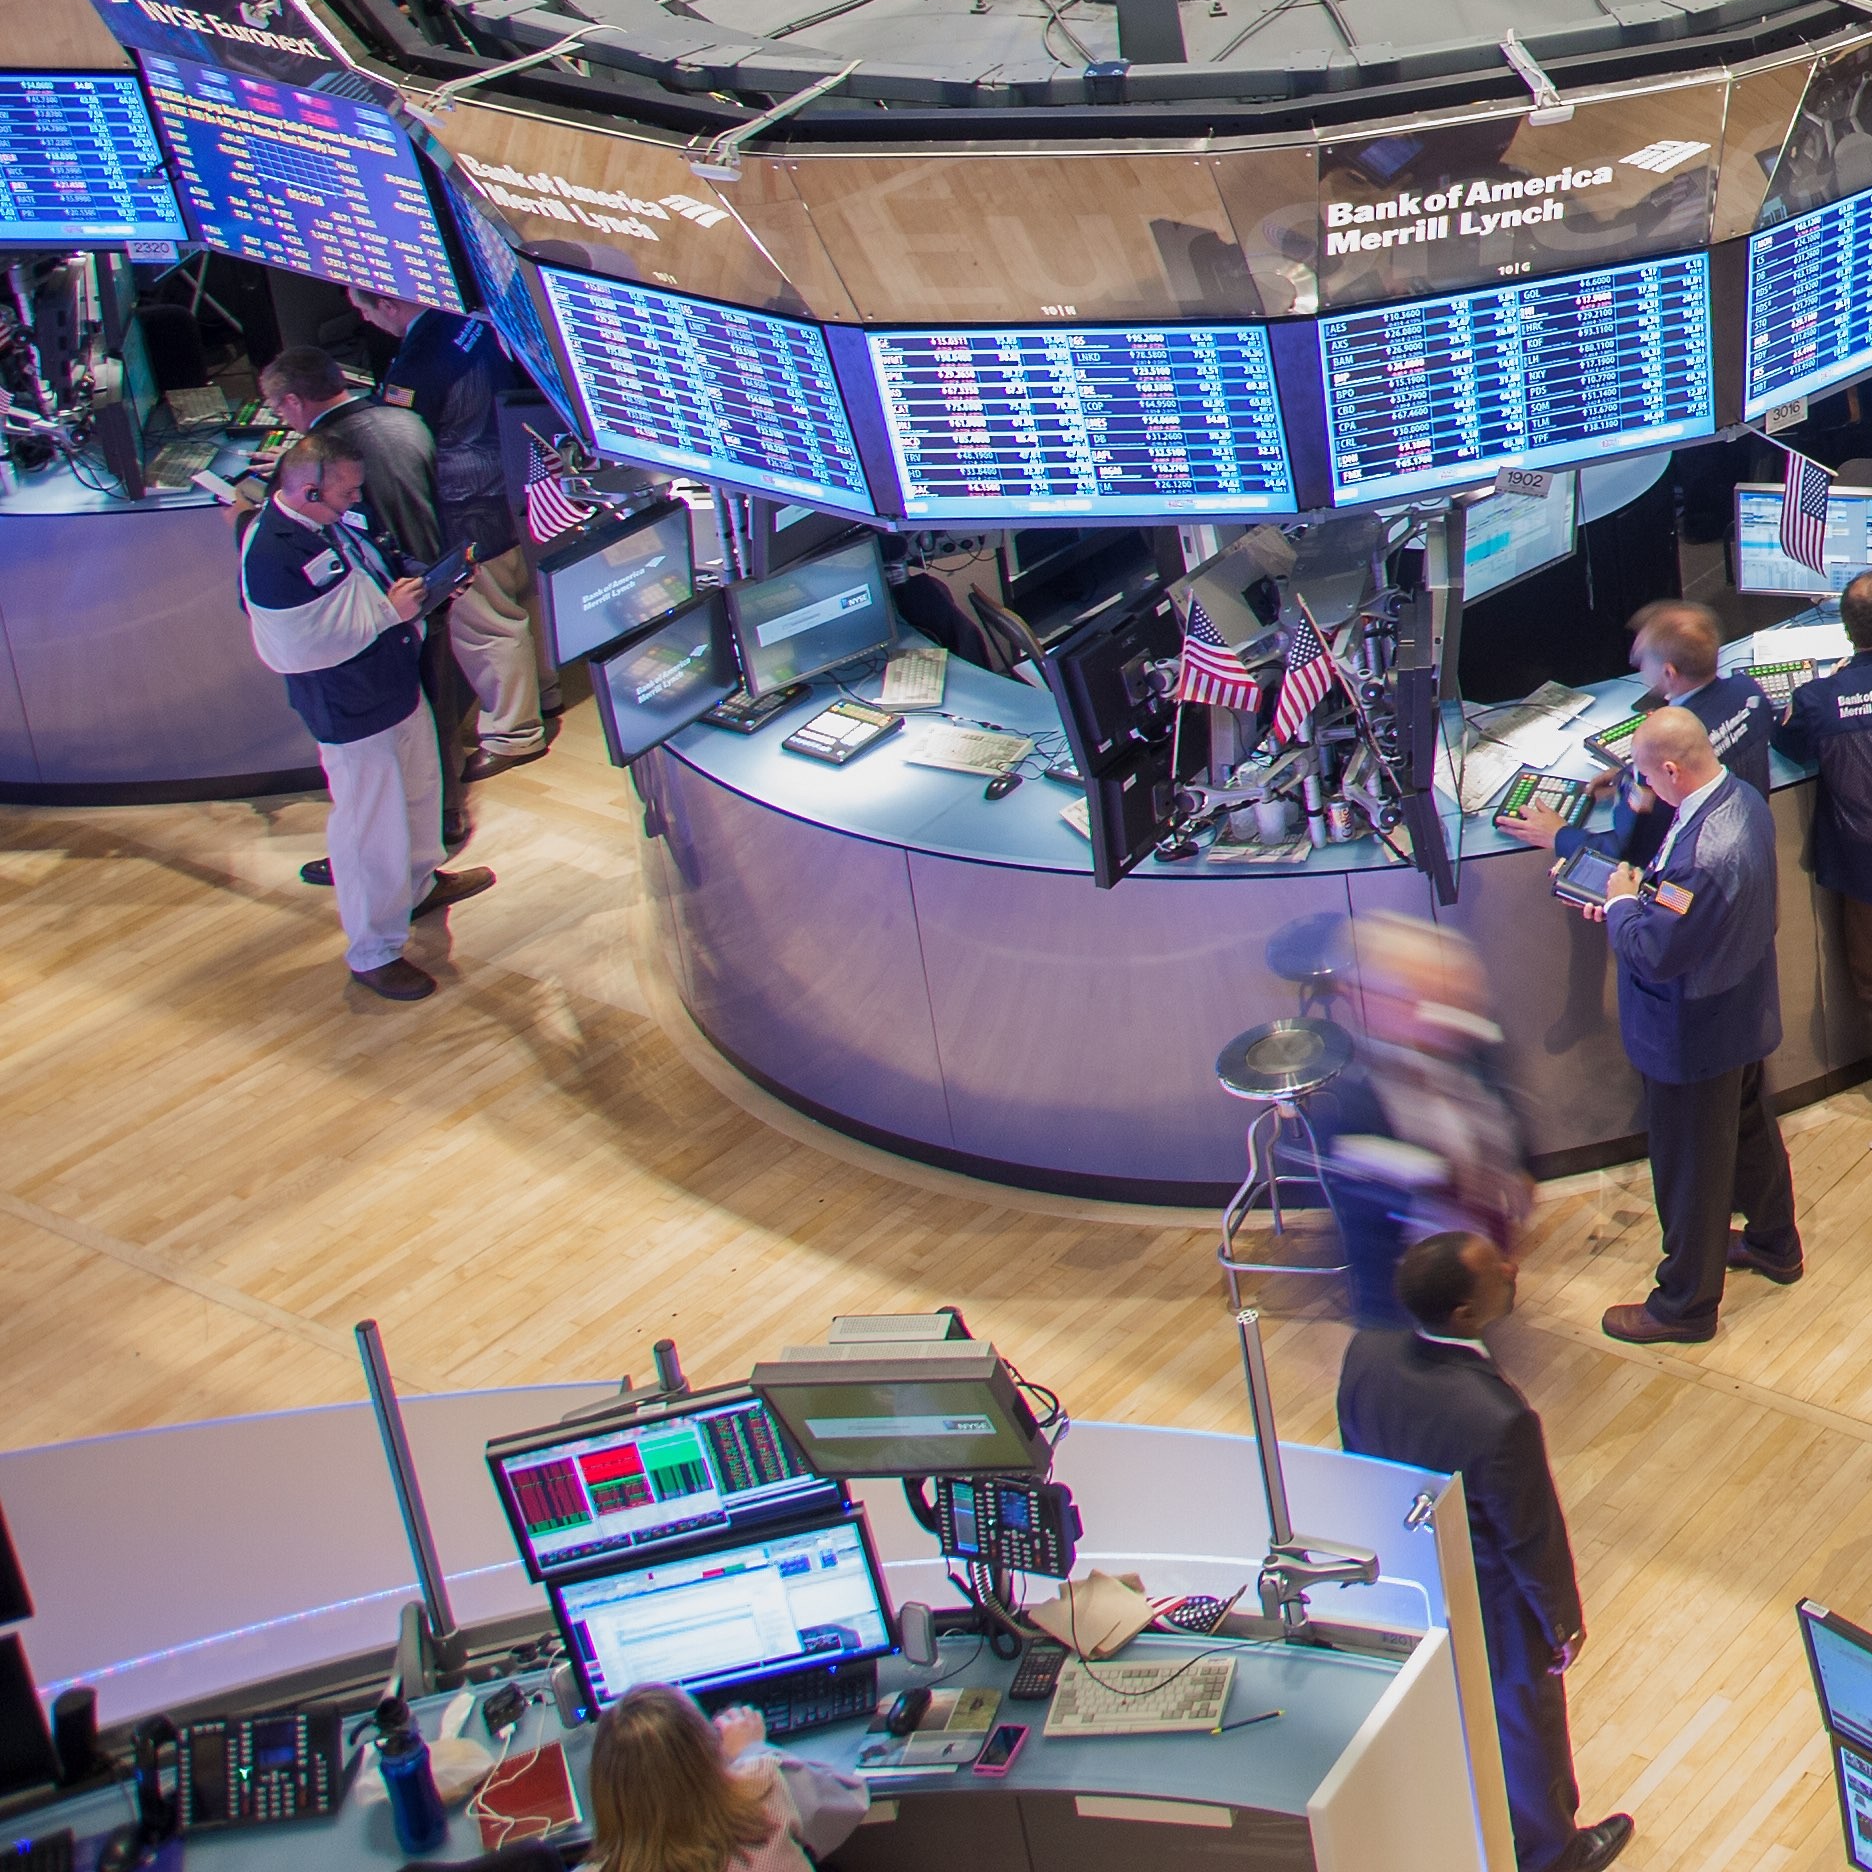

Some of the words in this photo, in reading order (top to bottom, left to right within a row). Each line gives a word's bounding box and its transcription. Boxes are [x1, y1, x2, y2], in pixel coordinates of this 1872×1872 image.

[456, 154, 524, 192] Bank
[525, 169, 555, 196] of
[549, 171, 671, 220] America
[1327, 191, 1421, 229] Bank
[1424, 185, 1464, 211] of
[1463, 165, 1614, 206] America
[484, 182, 580, 226] Merrill
[581, 206, 660, 243] Lynch
[1327, 215, 1449, 257] Merrill
[1460, 198, 1566, 237] Lynch
[135, 241, 170, 254] 2320
[1331, 338, 1349, 351] AXS
[1530, 385, 1547, 397] PDS
[1773, 402, 1801, 422] 3016
[1533, 433, 1550, 445] YPF
[1507, 469, 1544, 489] 1902
[1838, 693, 1864, 707] Bank
[1839, 704, 1872, 719] Merrill
